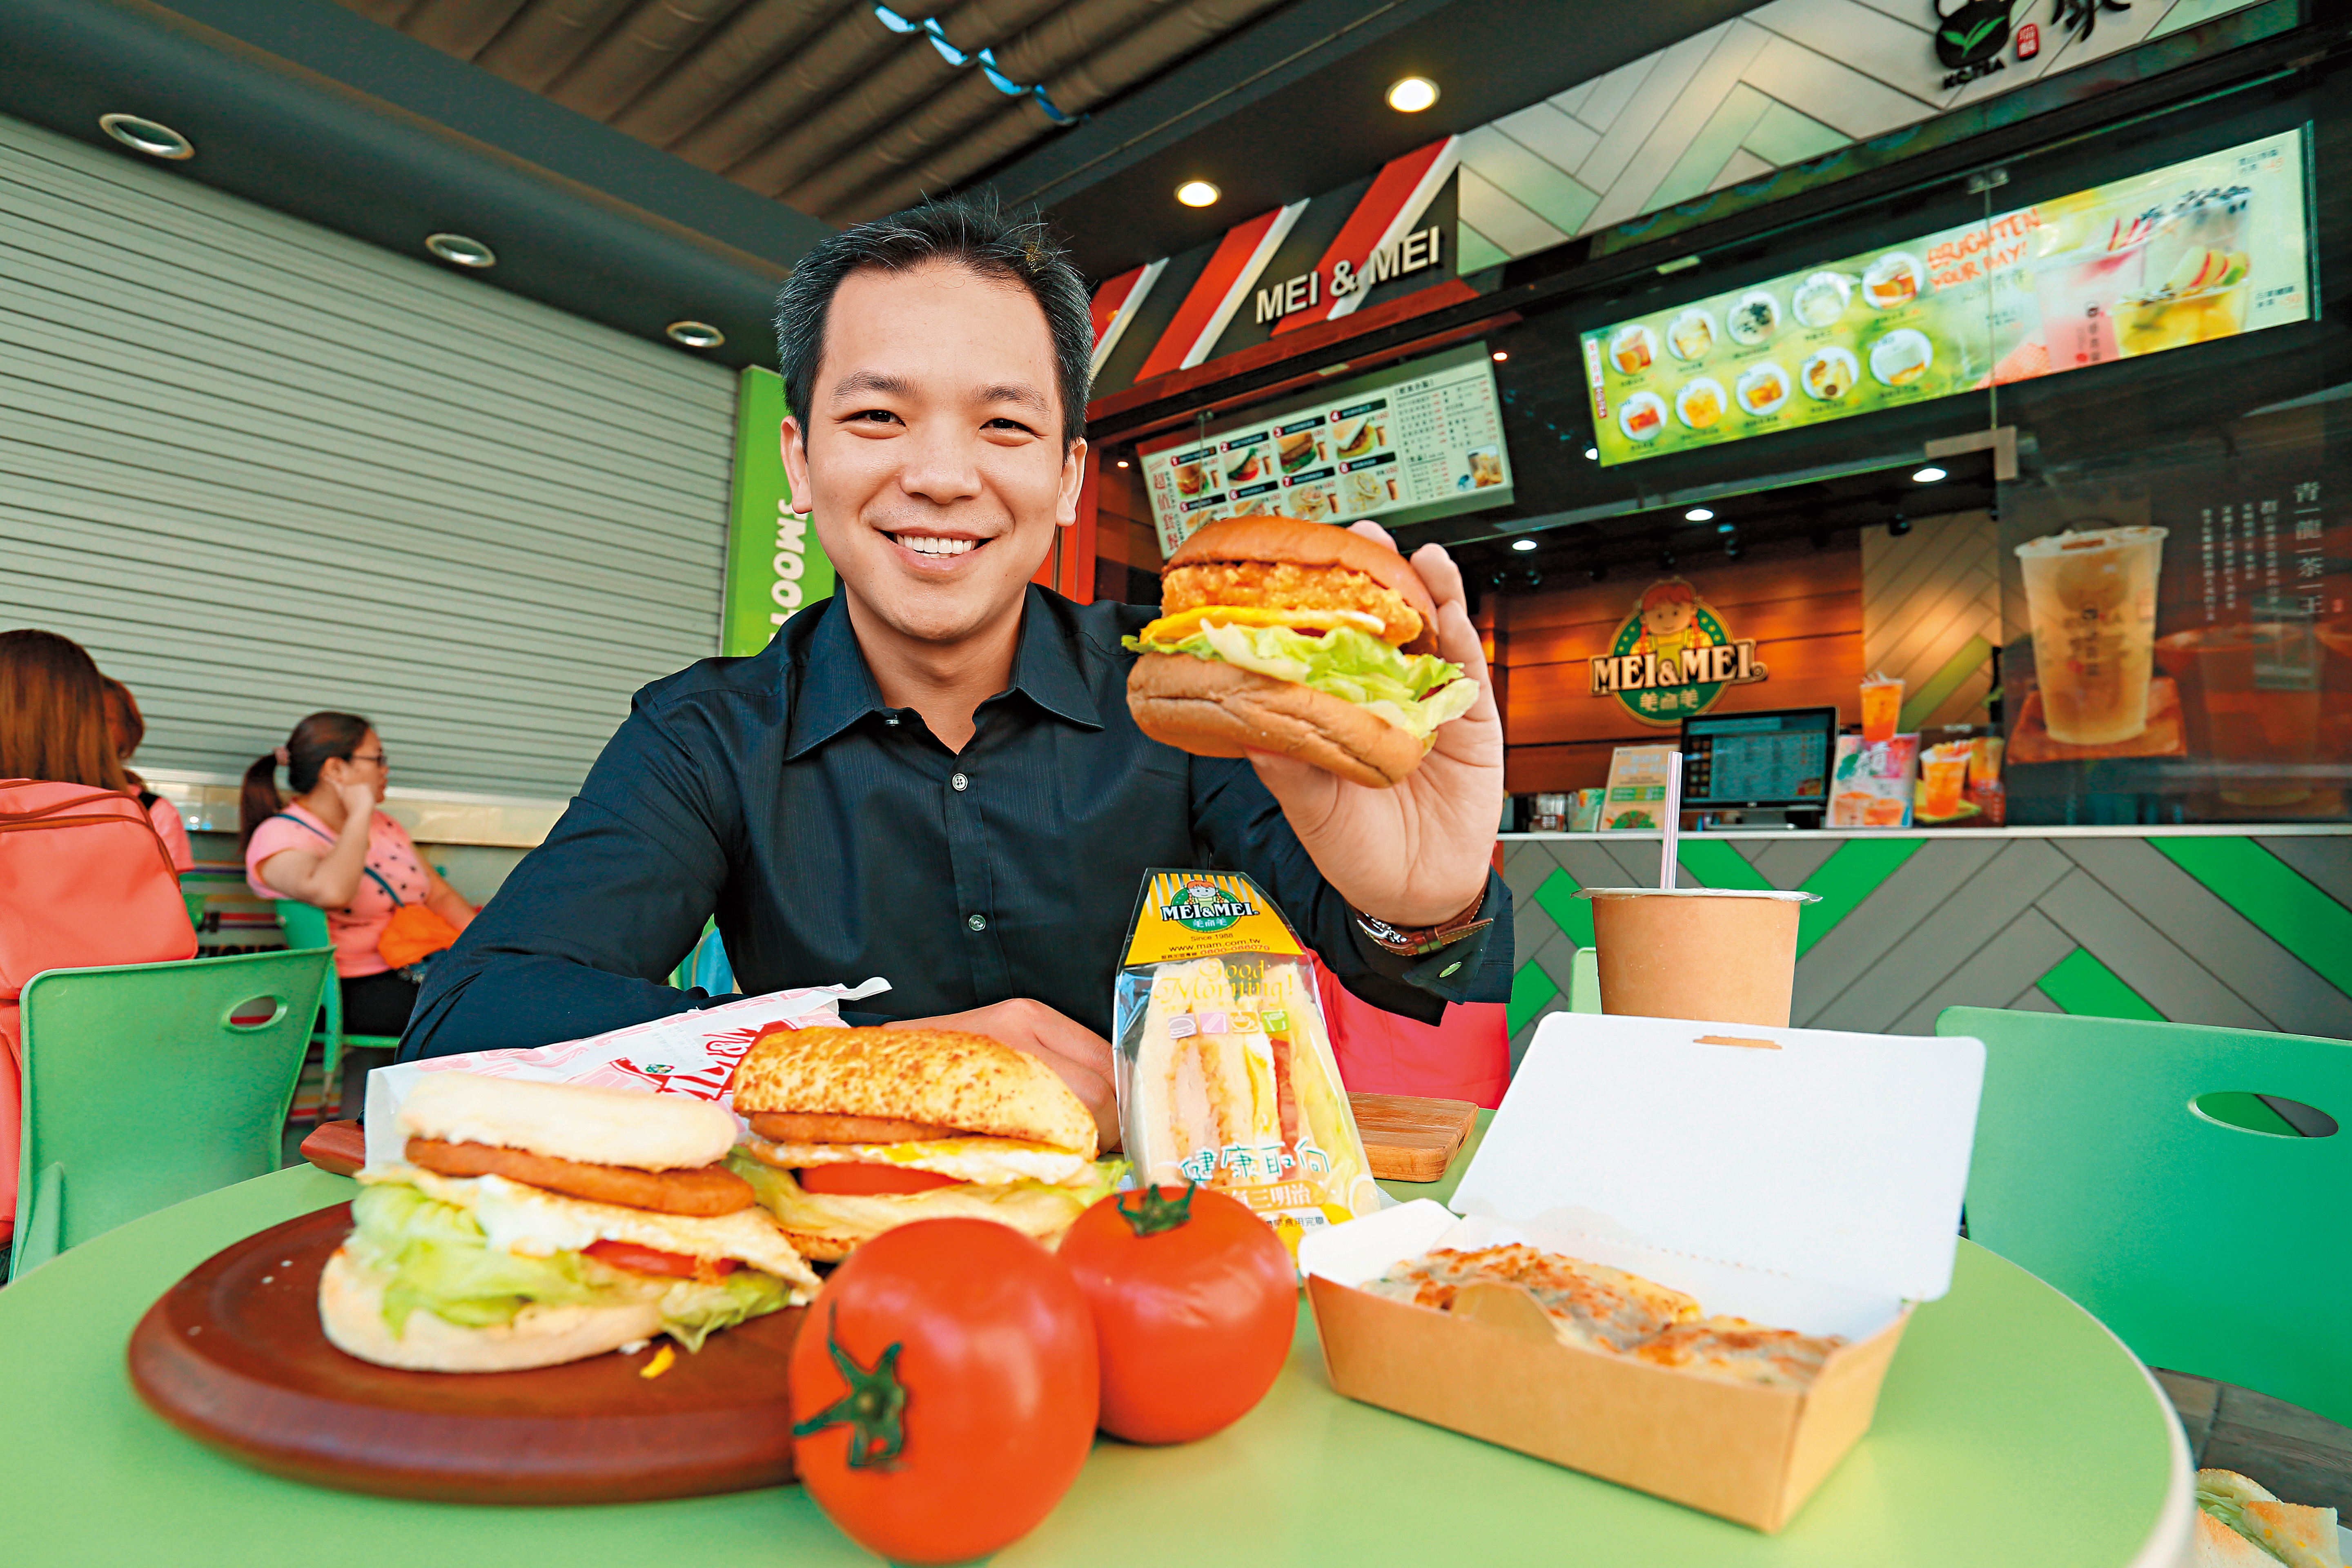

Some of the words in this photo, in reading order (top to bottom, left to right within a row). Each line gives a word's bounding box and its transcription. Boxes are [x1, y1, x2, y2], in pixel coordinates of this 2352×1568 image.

[1256, 272, 1319, 324] MEI
[1330, 260, 1358, 297] &
[1369, 225, 1440, 285] MEI
[1593, 643, 1752, 693] MEI&MEI
[1161, 902, 1253, 921] MEI&MEI
[1168, 938, 1261, 951] www.mam.com.tw
[1199, 958, 1265, 982] Good
[1154, 974, 1293, 1006] Morning!
[1178, 1137, 1330, 1182] 健康取向
